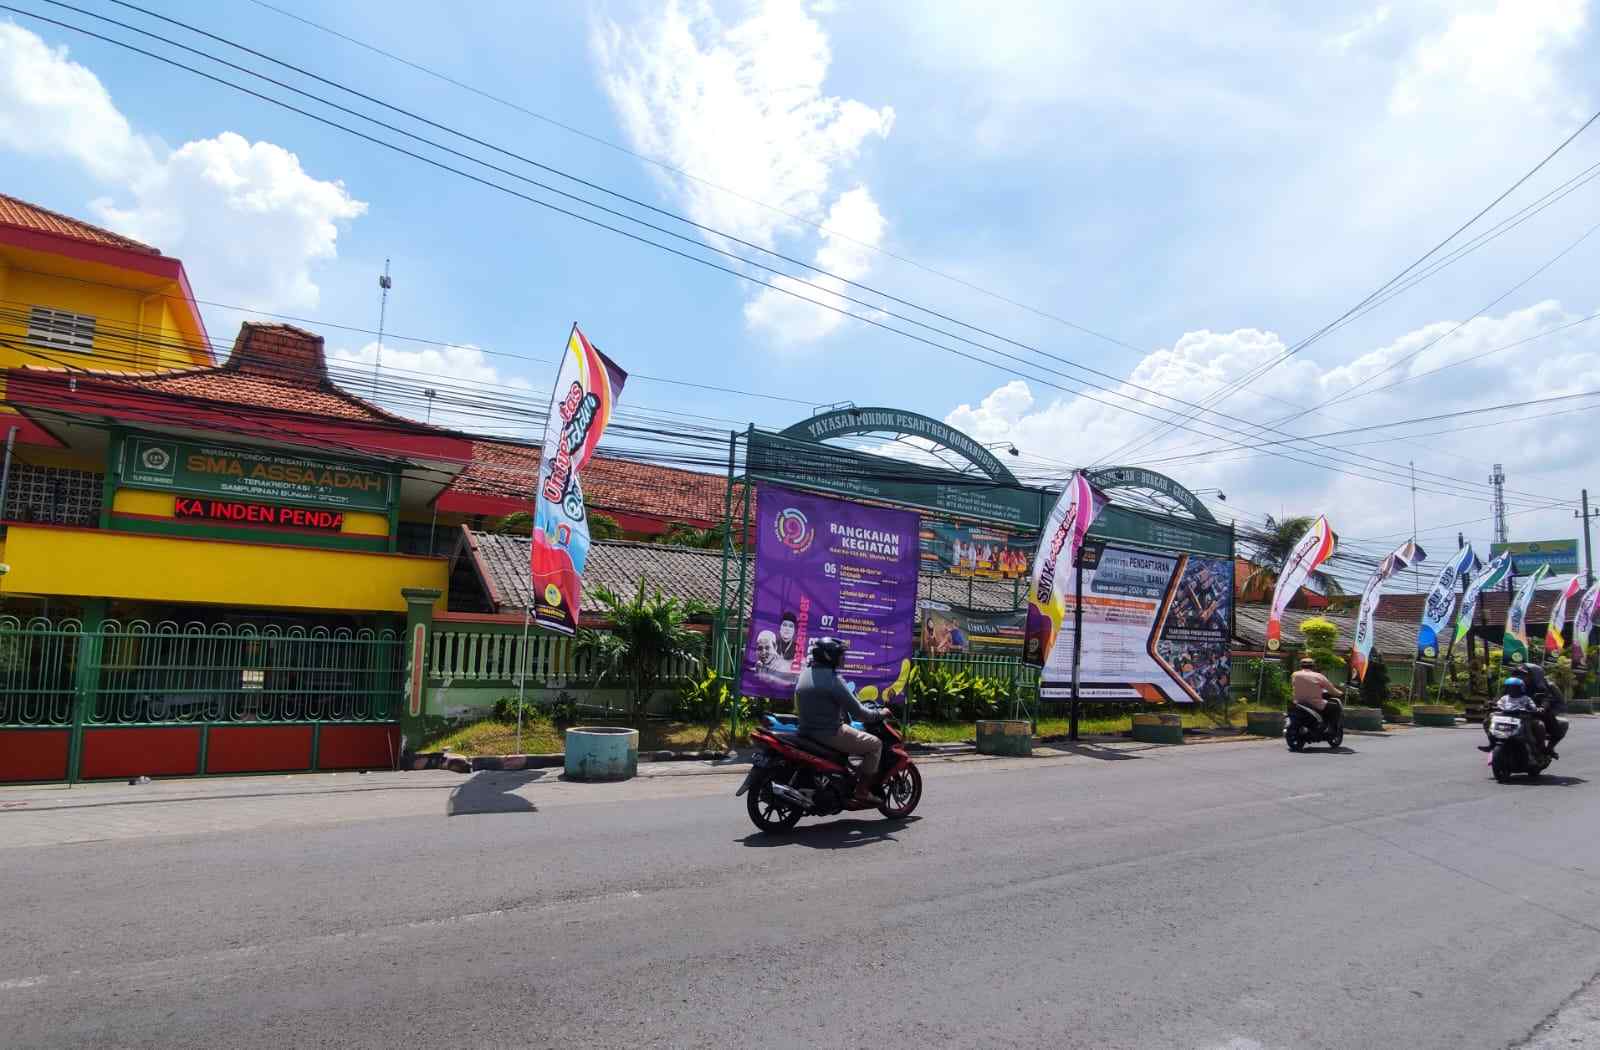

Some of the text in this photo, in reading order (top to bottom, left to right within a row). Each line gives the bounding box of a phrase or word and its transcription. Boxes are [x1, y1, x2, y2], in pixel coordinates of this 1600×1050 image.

[807, 414, 855, 438] YAYASAN
[856, 413, 896, 426] PONDOK
[896, 415, 949, 440] PESANTREN
[186, 455, 245, 477] SMA
[176, 499, 204, 516] KA
[210, 502, 275, 522] INDEN
[830, 523, 899, 545] RANGKAIAN
[842, 537, 899, 556] KEGIATAN
[824, 562, 837, 574] 06
[1129, 557, 1170, 570] PENDAFTARAN
[1037, 561, 1056, 604] SMK
[821, 615, 834, 627] 07
